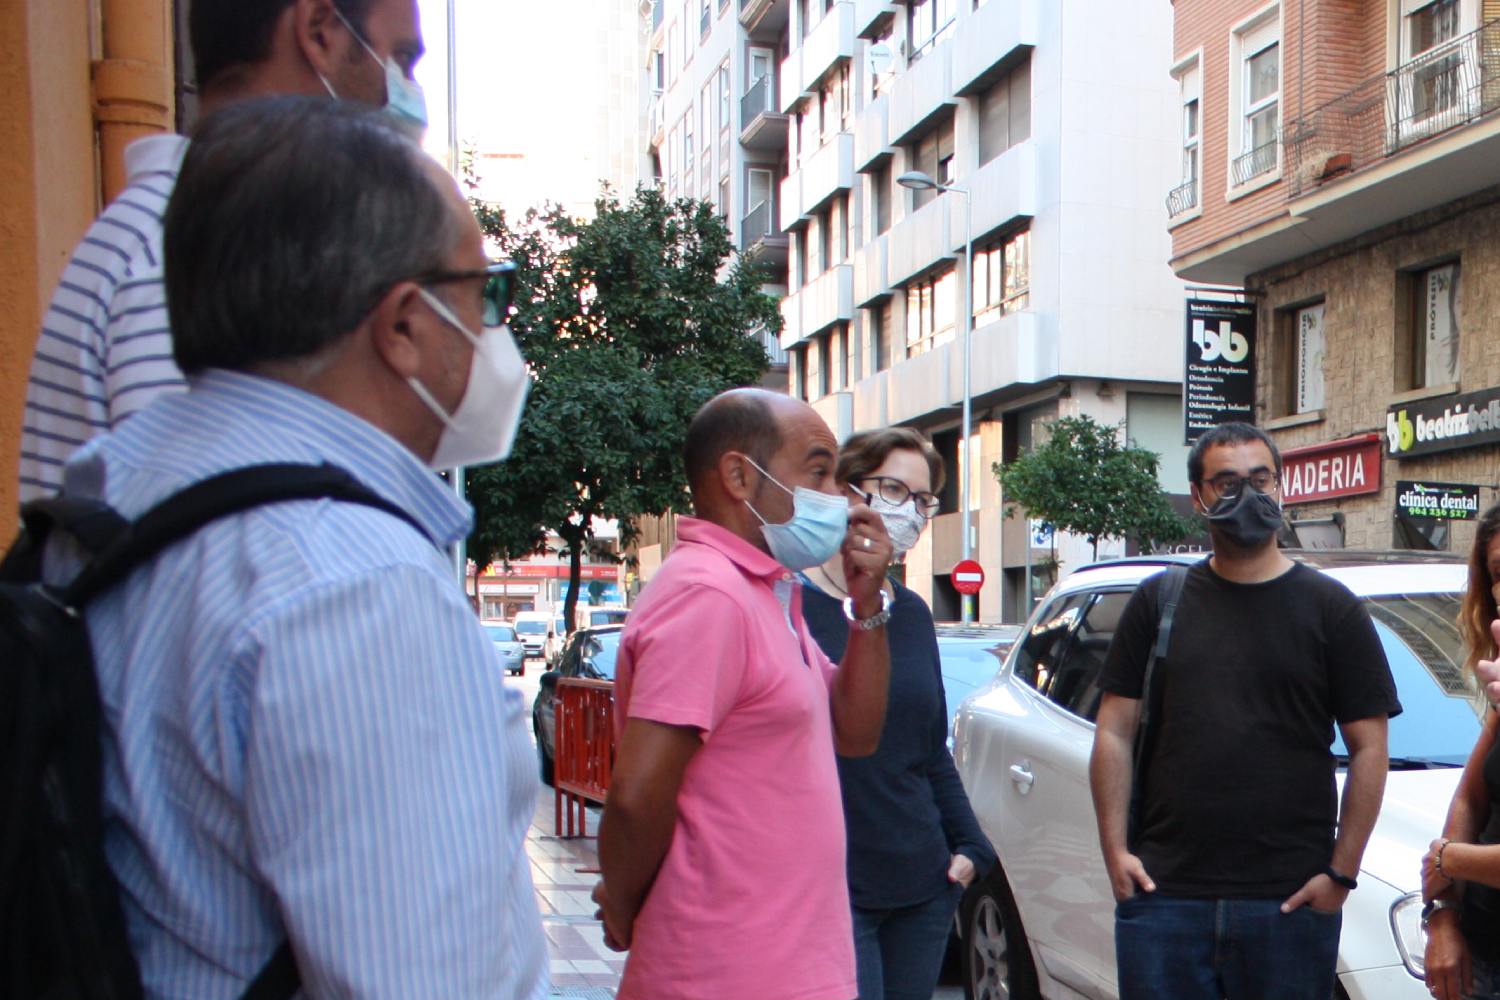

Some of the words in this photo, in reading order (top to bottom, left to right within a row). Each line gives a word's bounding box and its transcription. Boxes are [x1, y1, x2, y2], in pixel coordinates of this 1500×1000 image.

[1281, 453, 1365, 497] NADERIA
[1399, 490, 1438, 508] clínica
[1440, 492, 1477, 510] dental
[1408, 507, 1427, 516] 964
[1450, 509, 1467, 518] 527
